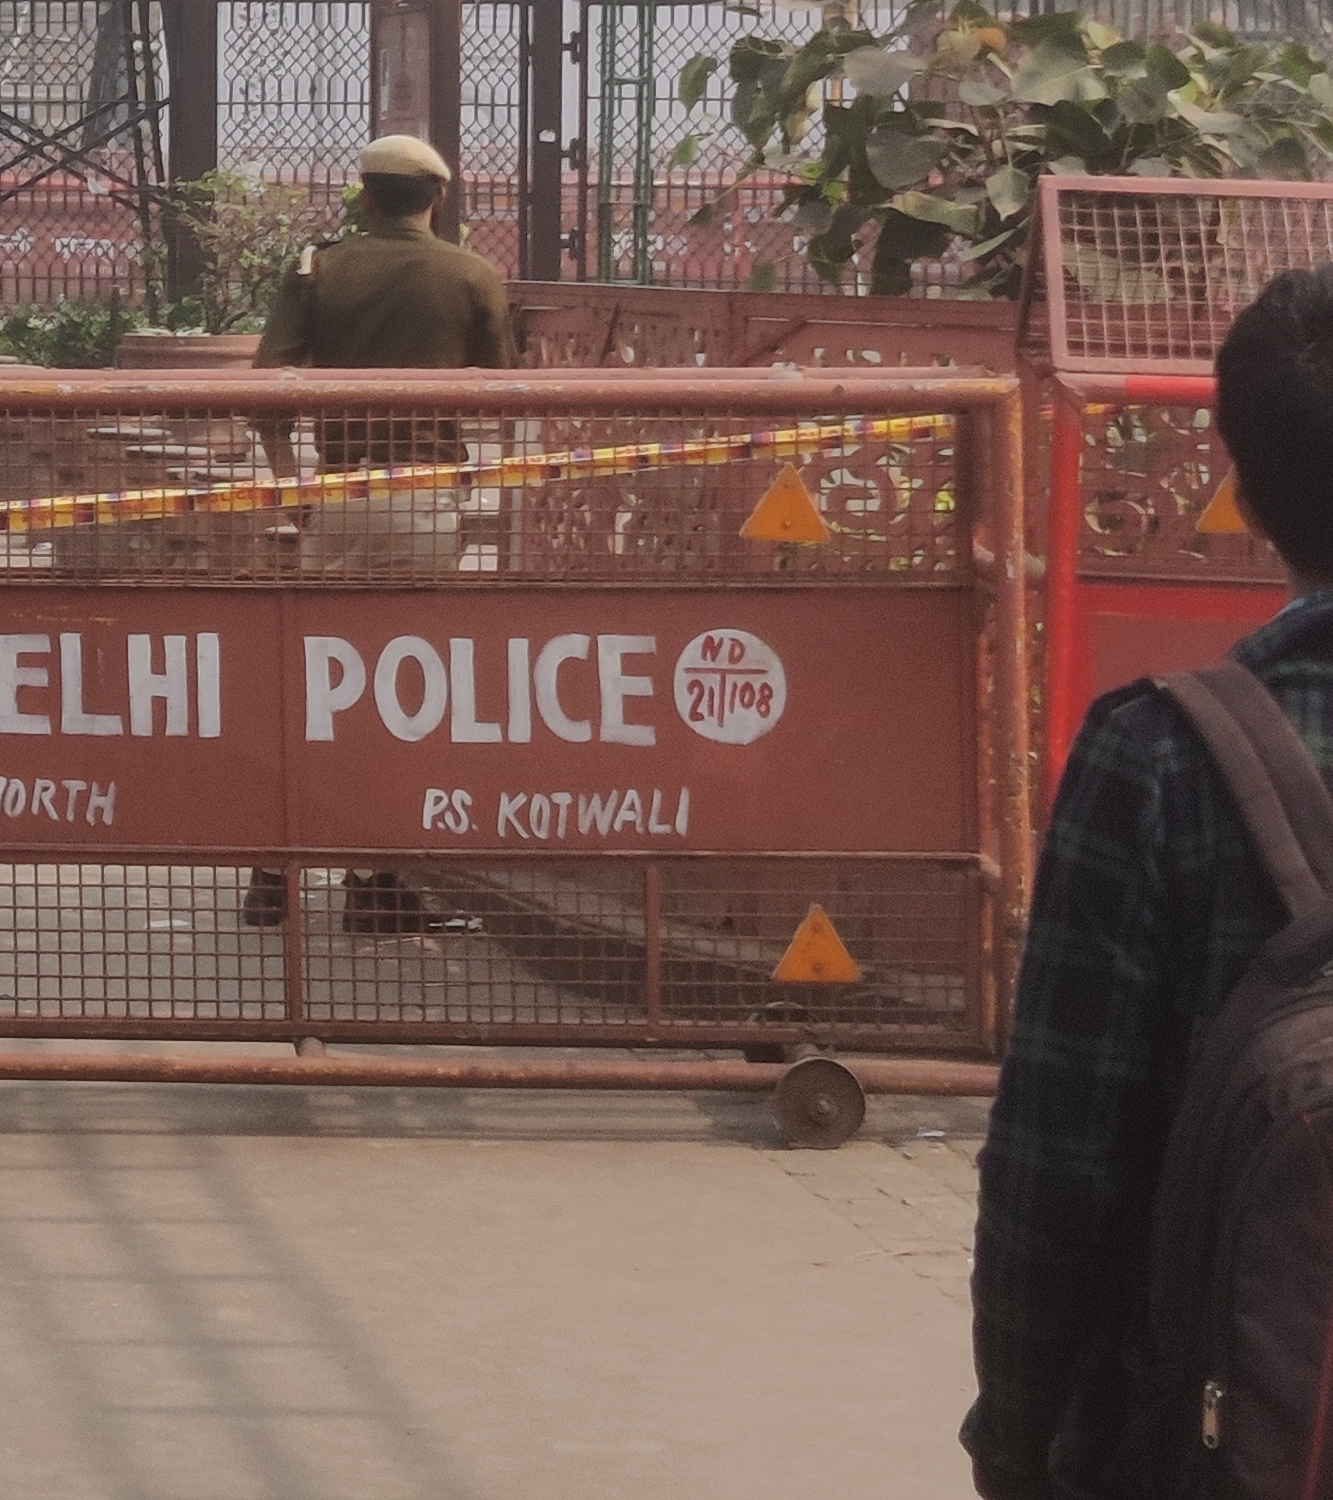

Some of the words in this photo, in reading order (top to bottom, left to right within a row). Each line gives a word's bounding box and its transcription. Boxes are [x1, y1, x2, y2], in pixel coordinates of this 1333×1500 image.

[701, 635, 746, 664] ND
[304, 634, 657, 746] POLICE
[497, 786, 690, 840] KOTWALI
